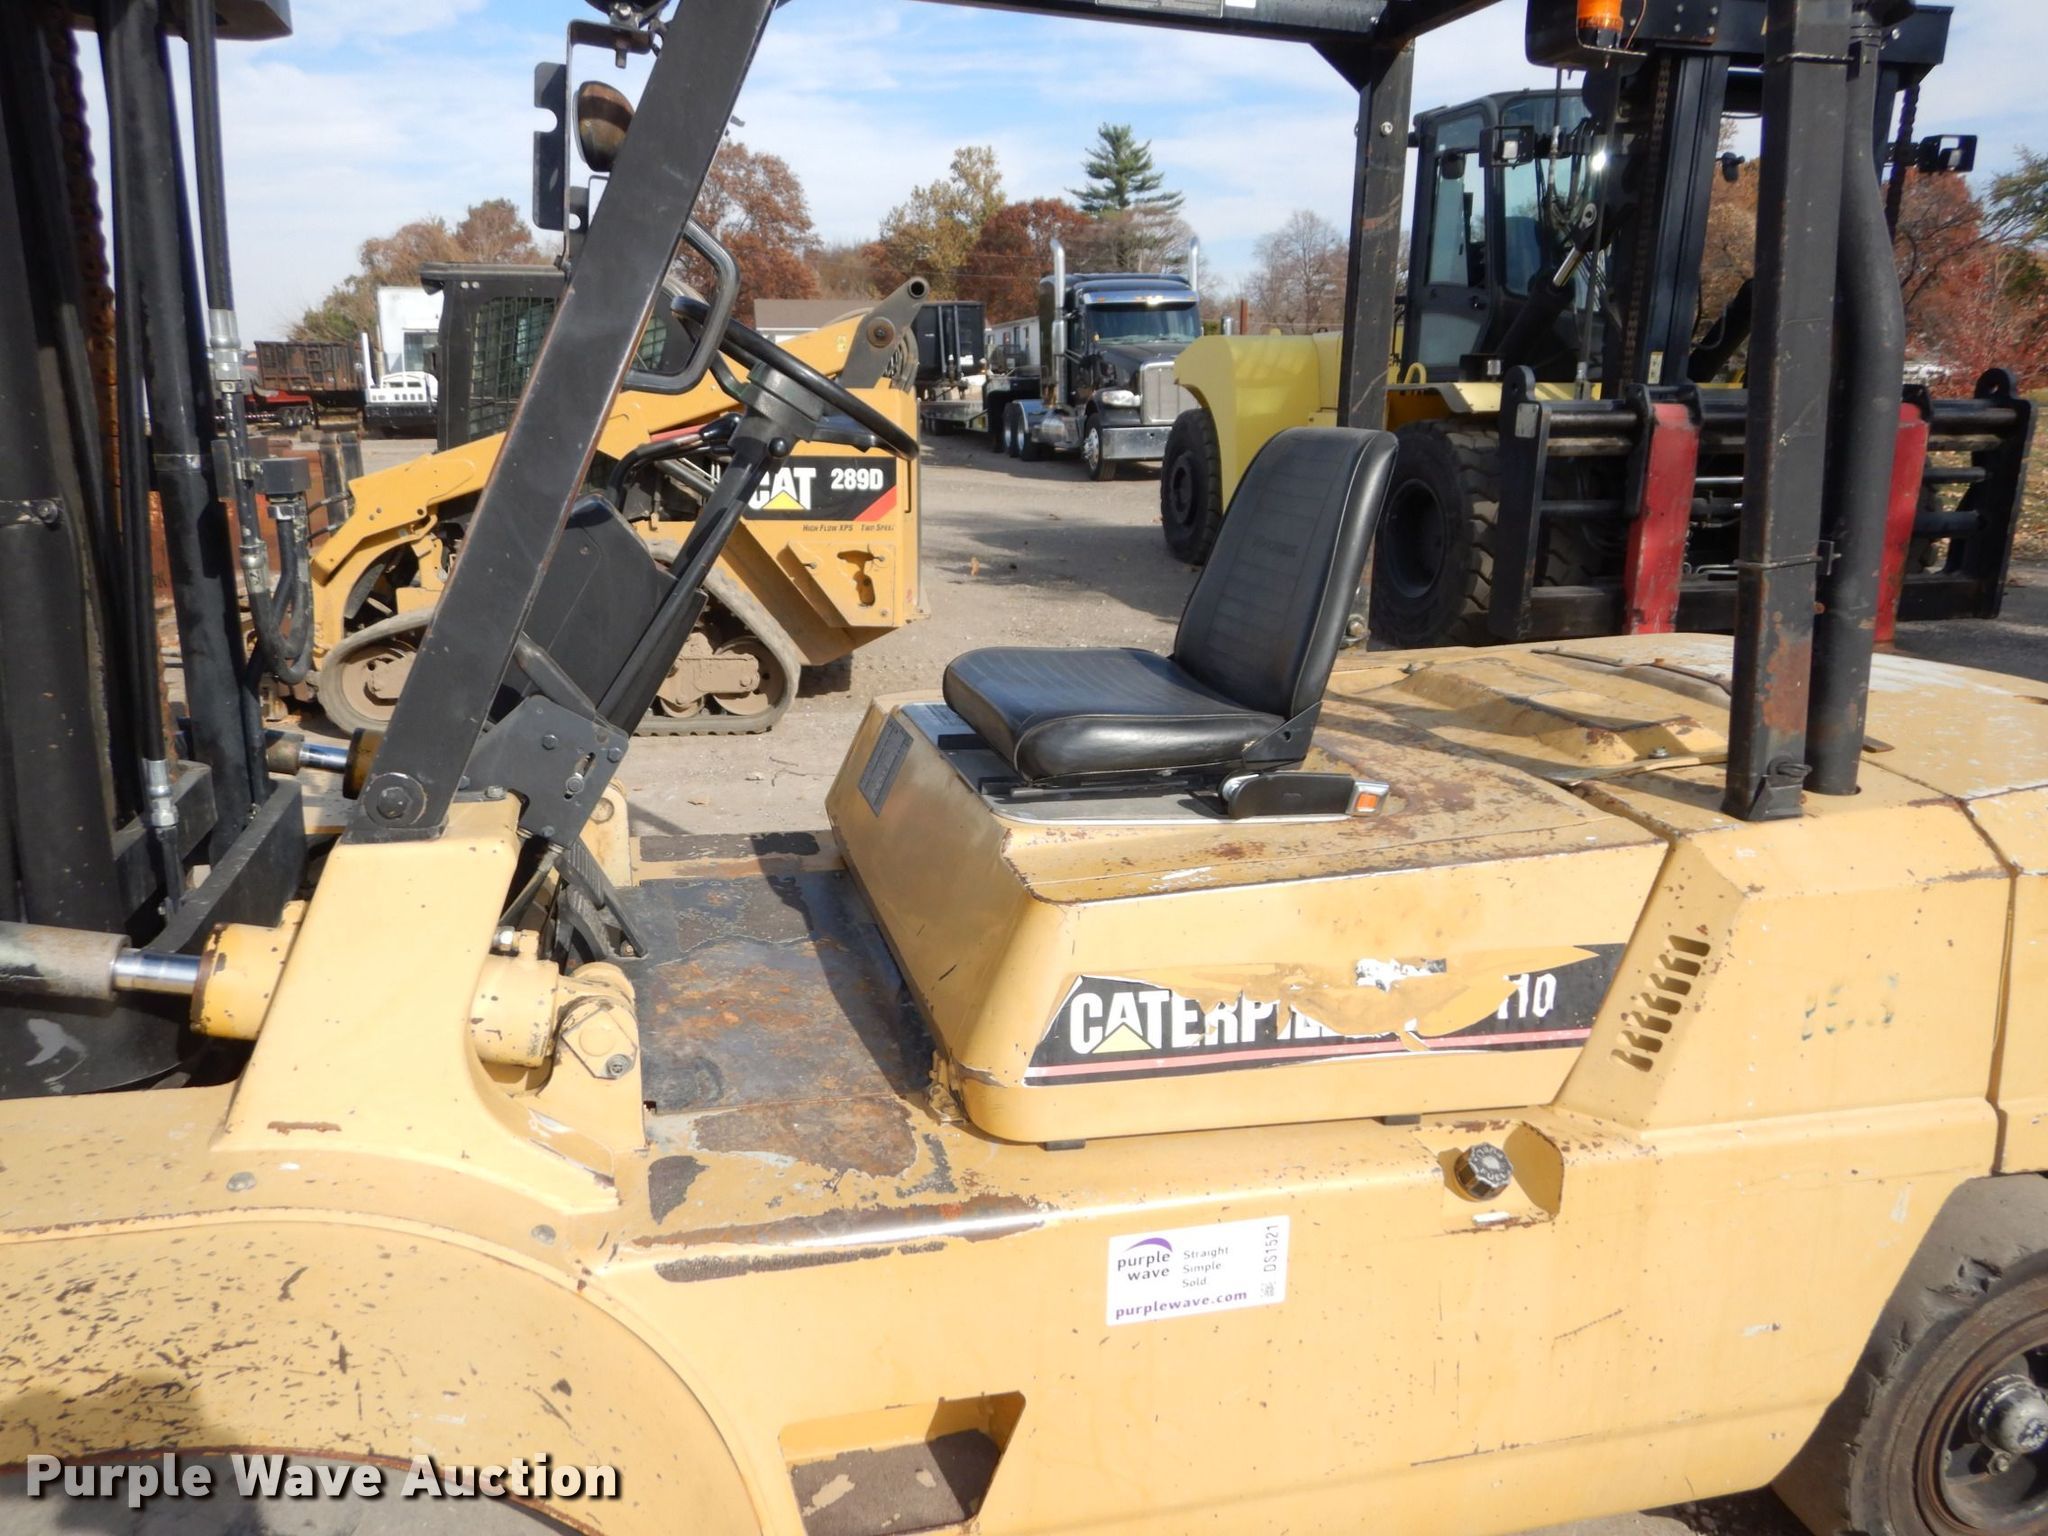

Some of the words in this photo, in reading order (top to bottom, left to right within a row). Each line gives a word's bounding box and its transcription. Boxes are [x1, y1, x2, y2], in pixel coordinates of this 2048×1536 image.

[748, 467, 816, 510] CAT
[830, 467, 884, 490] 289D
[1183, 1246, 1229, 1260] Straight
[1263, 1224, 1279, 1273] DS1521
[1117, 1250, 1171, 1271] purple
[1182, 1261, 1222, 1275] Simple
[1127, 1267, 1170, 1281] wave
[1182, 1276, 1207, 1288] Sold
[1115, 1290, 1248, 1320] purplewave.com
